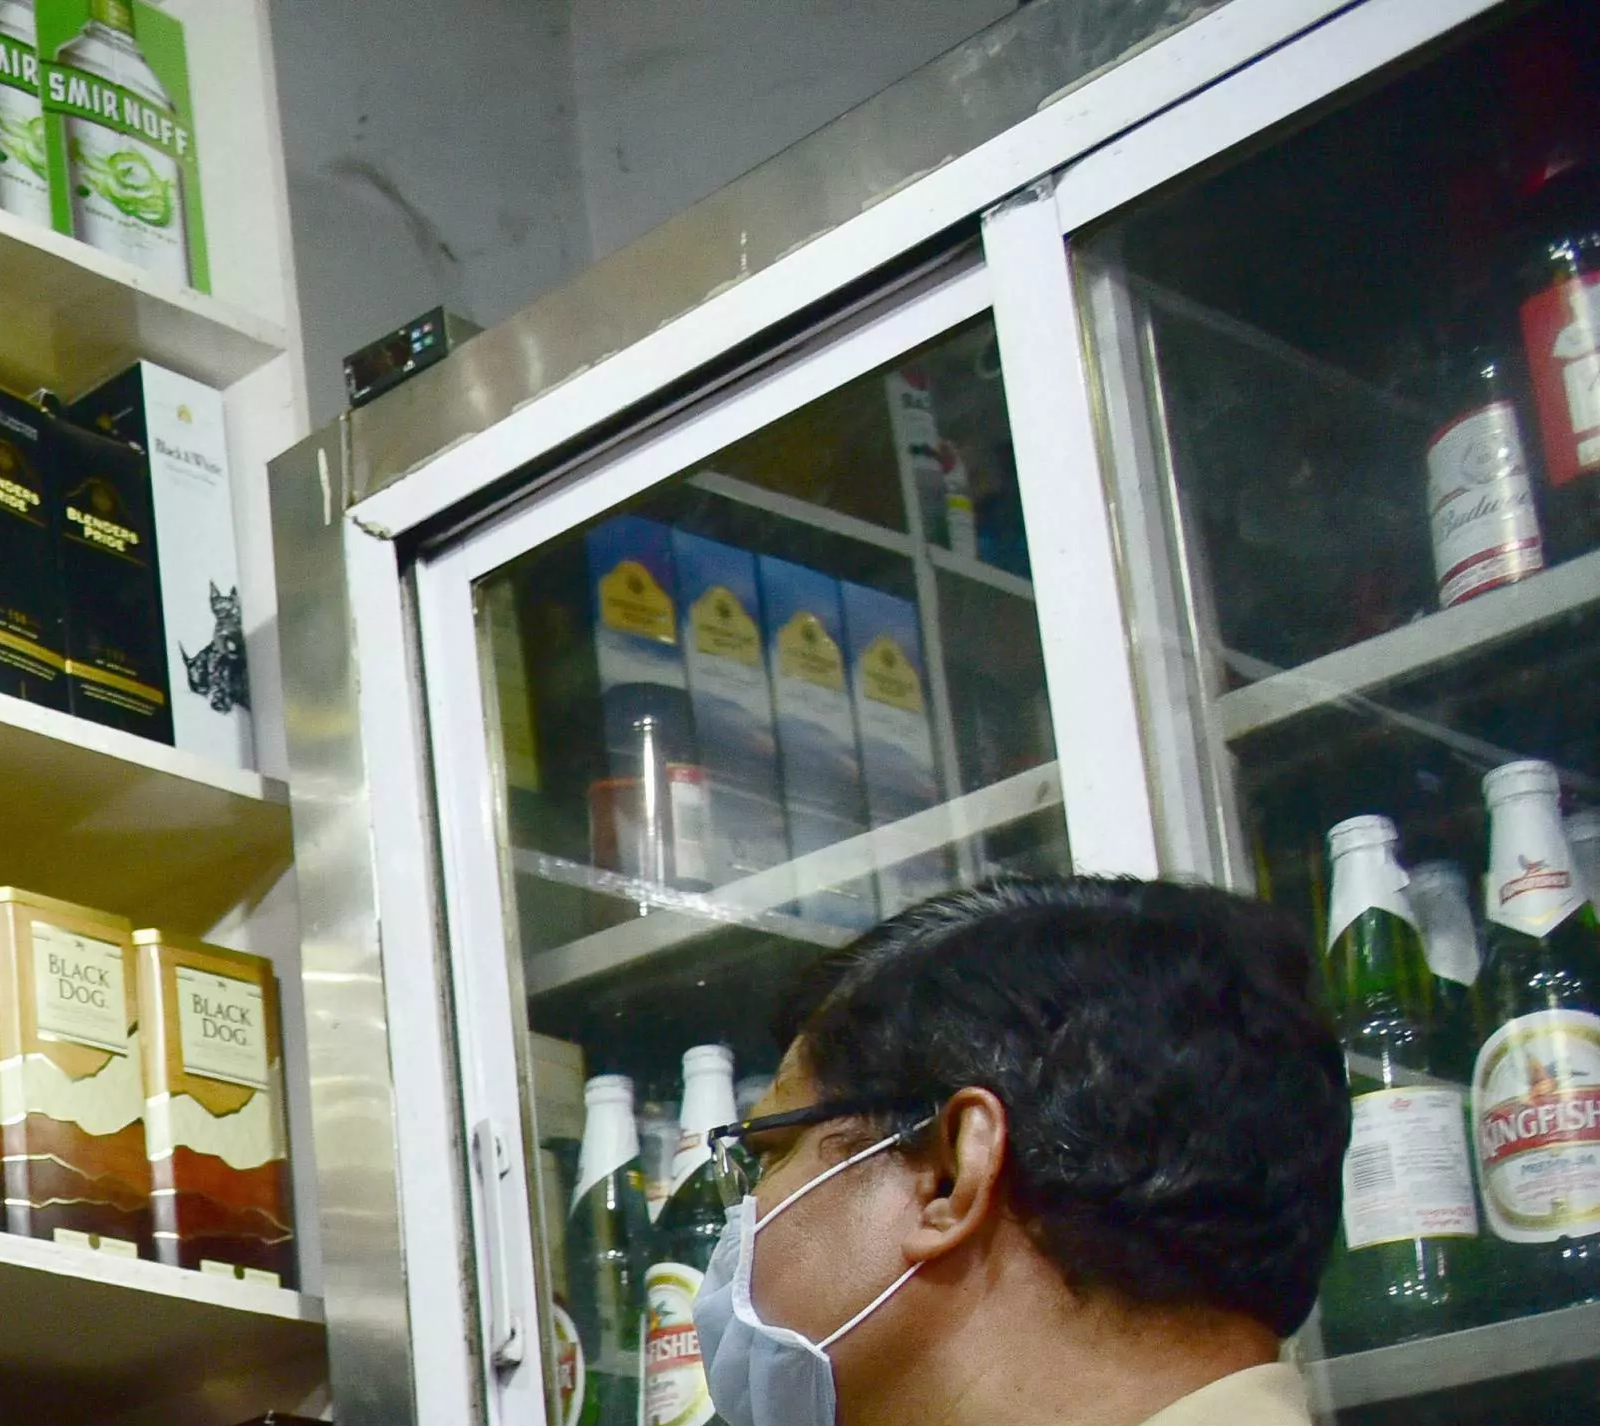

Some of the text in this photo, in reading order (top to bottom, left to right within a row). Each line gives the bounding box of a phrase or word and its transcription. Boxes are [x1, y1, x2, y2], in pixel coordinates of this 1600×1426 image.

[49, 72, 189, 156] SMIRNOFF
[66, 506, 139, 545] BLENDERS
[83, 526, 126, 552] PRIDE
[48, 952, 111, 990] BLACK
[58, 977, 107, 1009] DOG
[191, 992, 253, 1028] BLACK
[201, 1017, 248, 1047] DOG
[1483, 1099, 1600, 1158] KINGFISH
